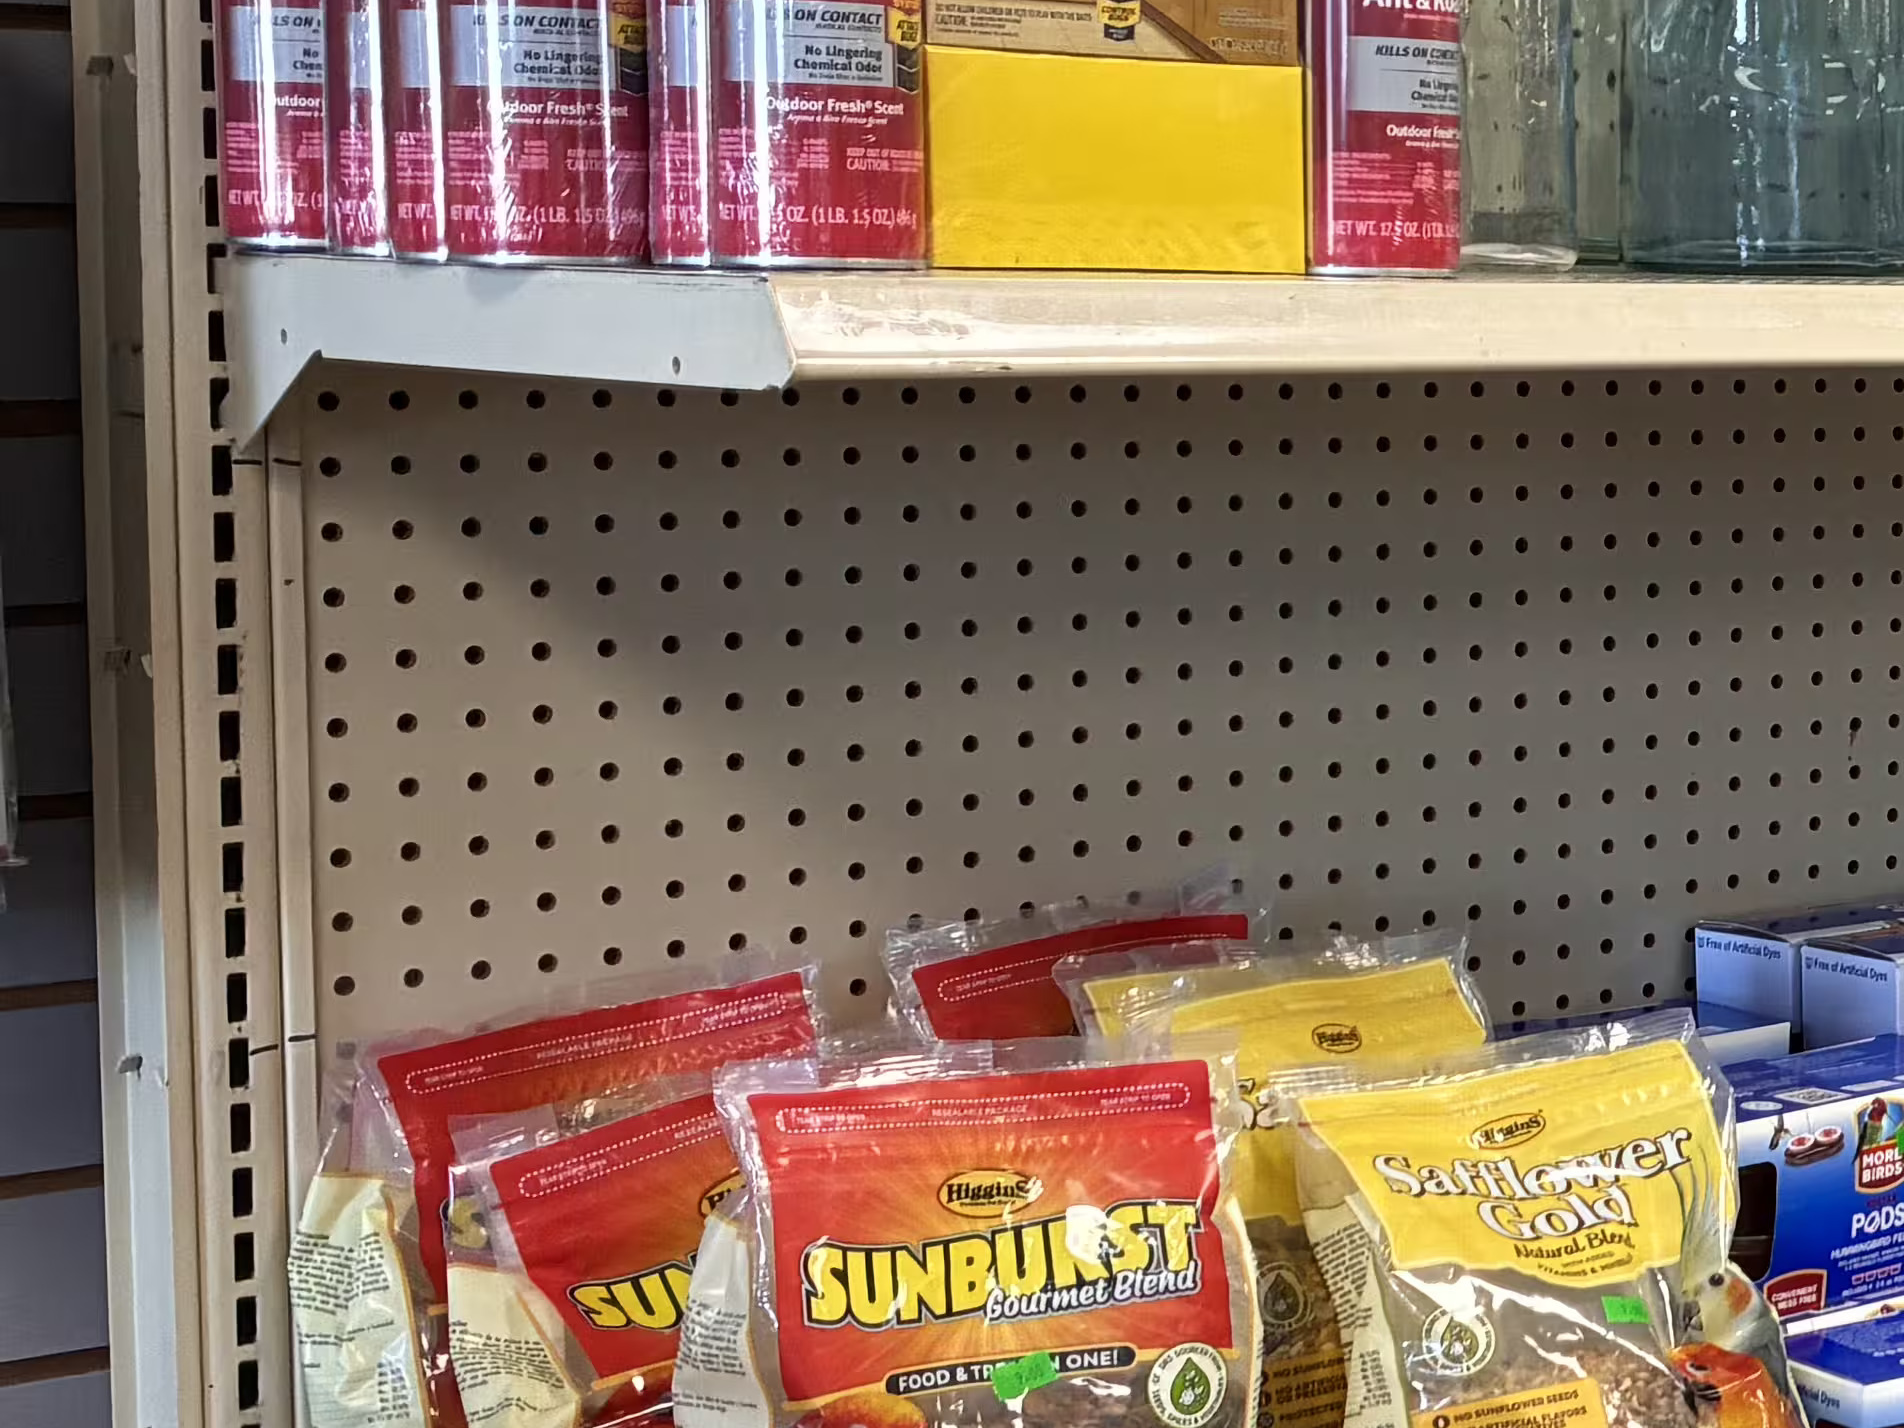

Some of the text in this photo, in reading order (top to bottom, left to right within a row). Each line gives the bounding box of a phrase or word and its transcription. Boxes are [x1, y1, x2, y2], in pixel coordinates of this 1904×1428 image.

[820, 10, 883, 26] CONTACT
[793, 58, 853, 72] Chemical
[825, 47, 883, 63] Lingering
[1706, 935, 1783, 961] Free Artificial Dyes
[1372, 1125, 1693, 1201] Safflower
[1476, 1184, 1640, 1242] Gold
[1513, 1234, 1586, 1259] Natural
[803, 1200, 1203, 1329] SUNBURST
[984, 1261, 1202, 1323] Gourmet Blend
[1065, 1349, 1120, 1370] ONE!
[897, 1370, 953, 1391] FOOD
[1474, 1398, 1544, 1421] SUNFLOWER
